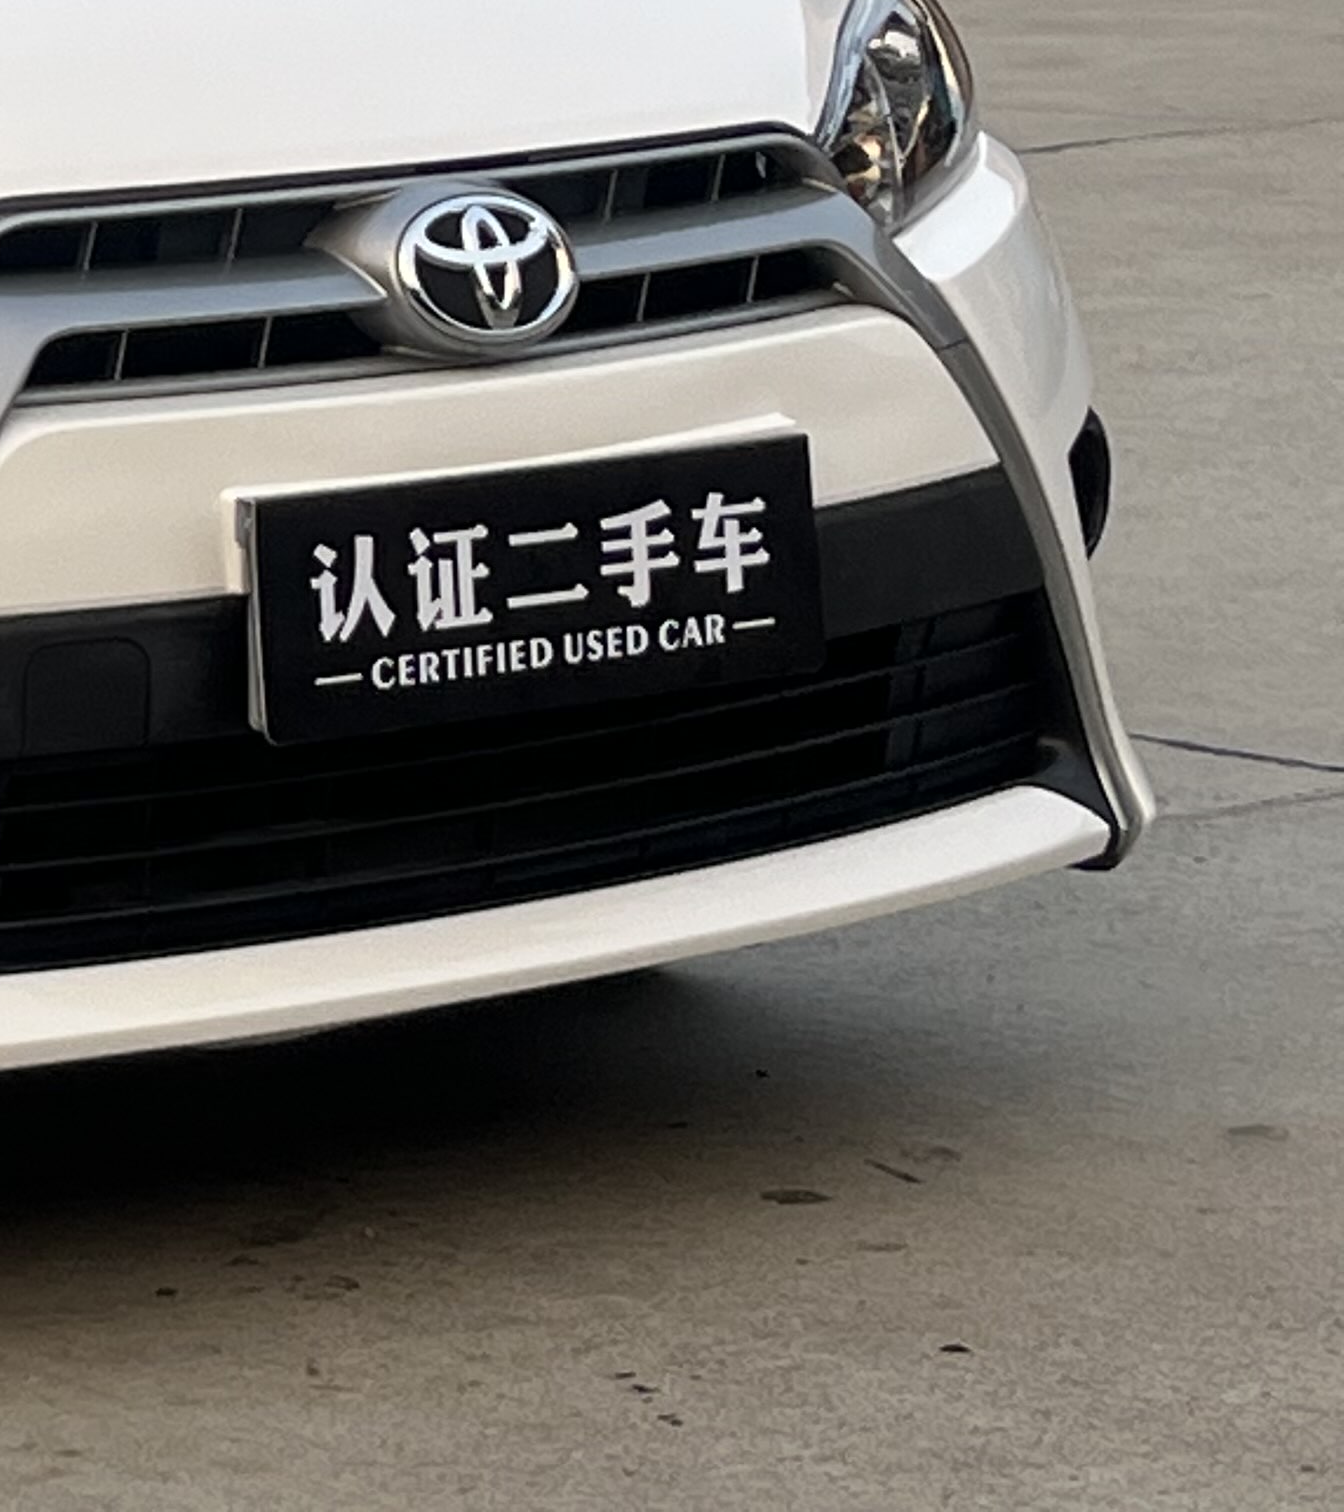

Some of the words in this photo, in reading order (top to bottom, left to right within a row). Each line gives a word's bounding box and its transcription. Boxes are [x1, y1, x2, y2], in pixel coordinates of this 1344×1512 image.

[310, 491, 771, 643] 认证二手车
[371, 636, 554, 689] CERTIFIED
[563, 625, 650, 664] USED
[658, 614, 726, 651] CAR
